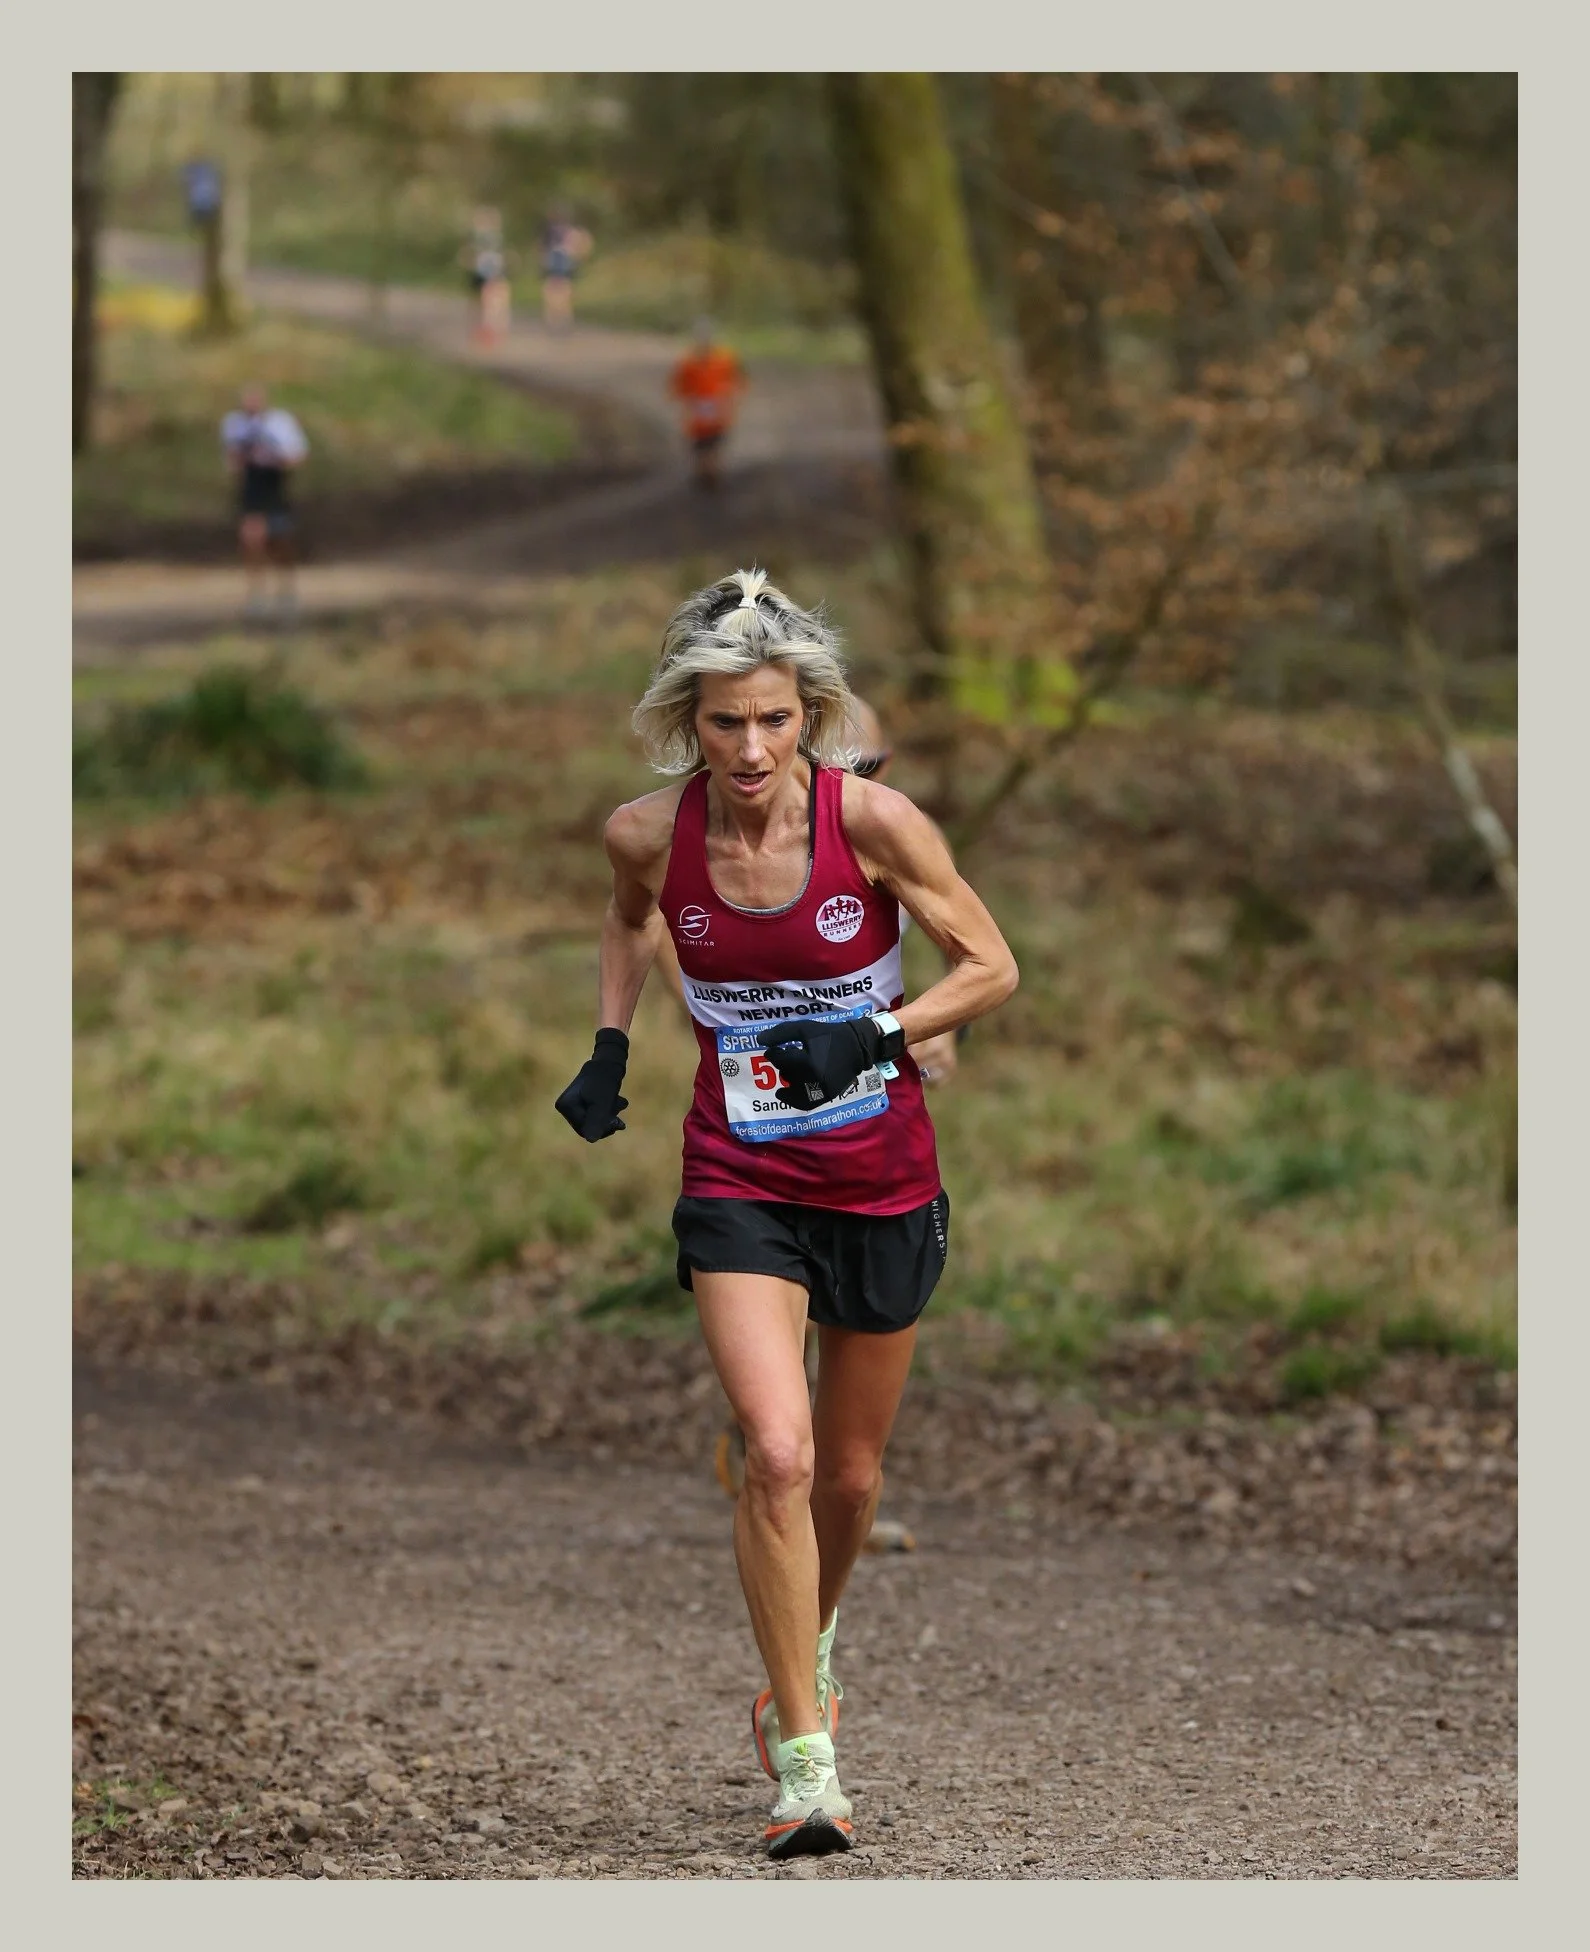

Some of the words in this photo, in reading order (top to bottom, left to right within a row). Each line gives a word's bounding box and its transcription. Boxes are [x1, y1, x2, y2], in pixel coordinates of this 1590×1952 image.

[822, 914, 862, 930] LLISWERRY
[679, 938, 715, 947] SCIMITAR
[692, 984, 785, 1003] LLISWERRY
[738, 1003, 834, 1021] NEWPORT
[750, 1056, 790, 1091] 5
